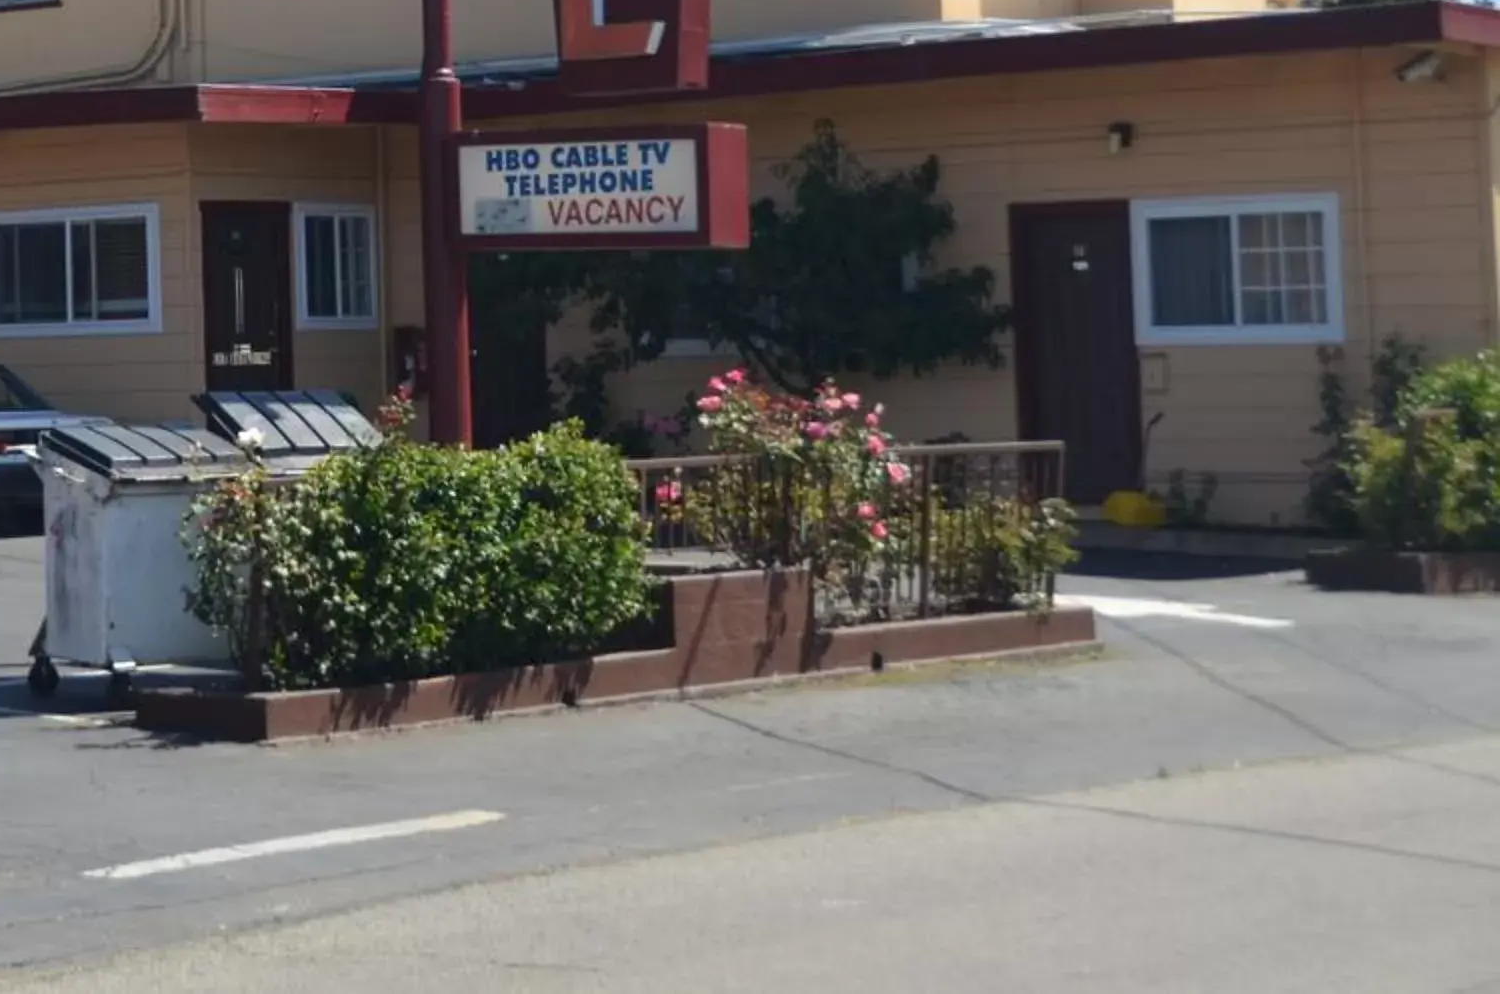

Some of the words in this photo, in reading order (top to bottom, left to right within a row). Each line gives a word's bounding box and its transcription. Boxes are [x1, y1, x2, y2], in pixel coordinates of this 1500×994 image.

[485, 149, 540, 172] HBO
[551, 144, 629, 168] CABLE
[637, 142, 671, 164] TV
[504, 170, 654, 196] TELEPHONE
[547, 195, 685, 226] VACANCY
